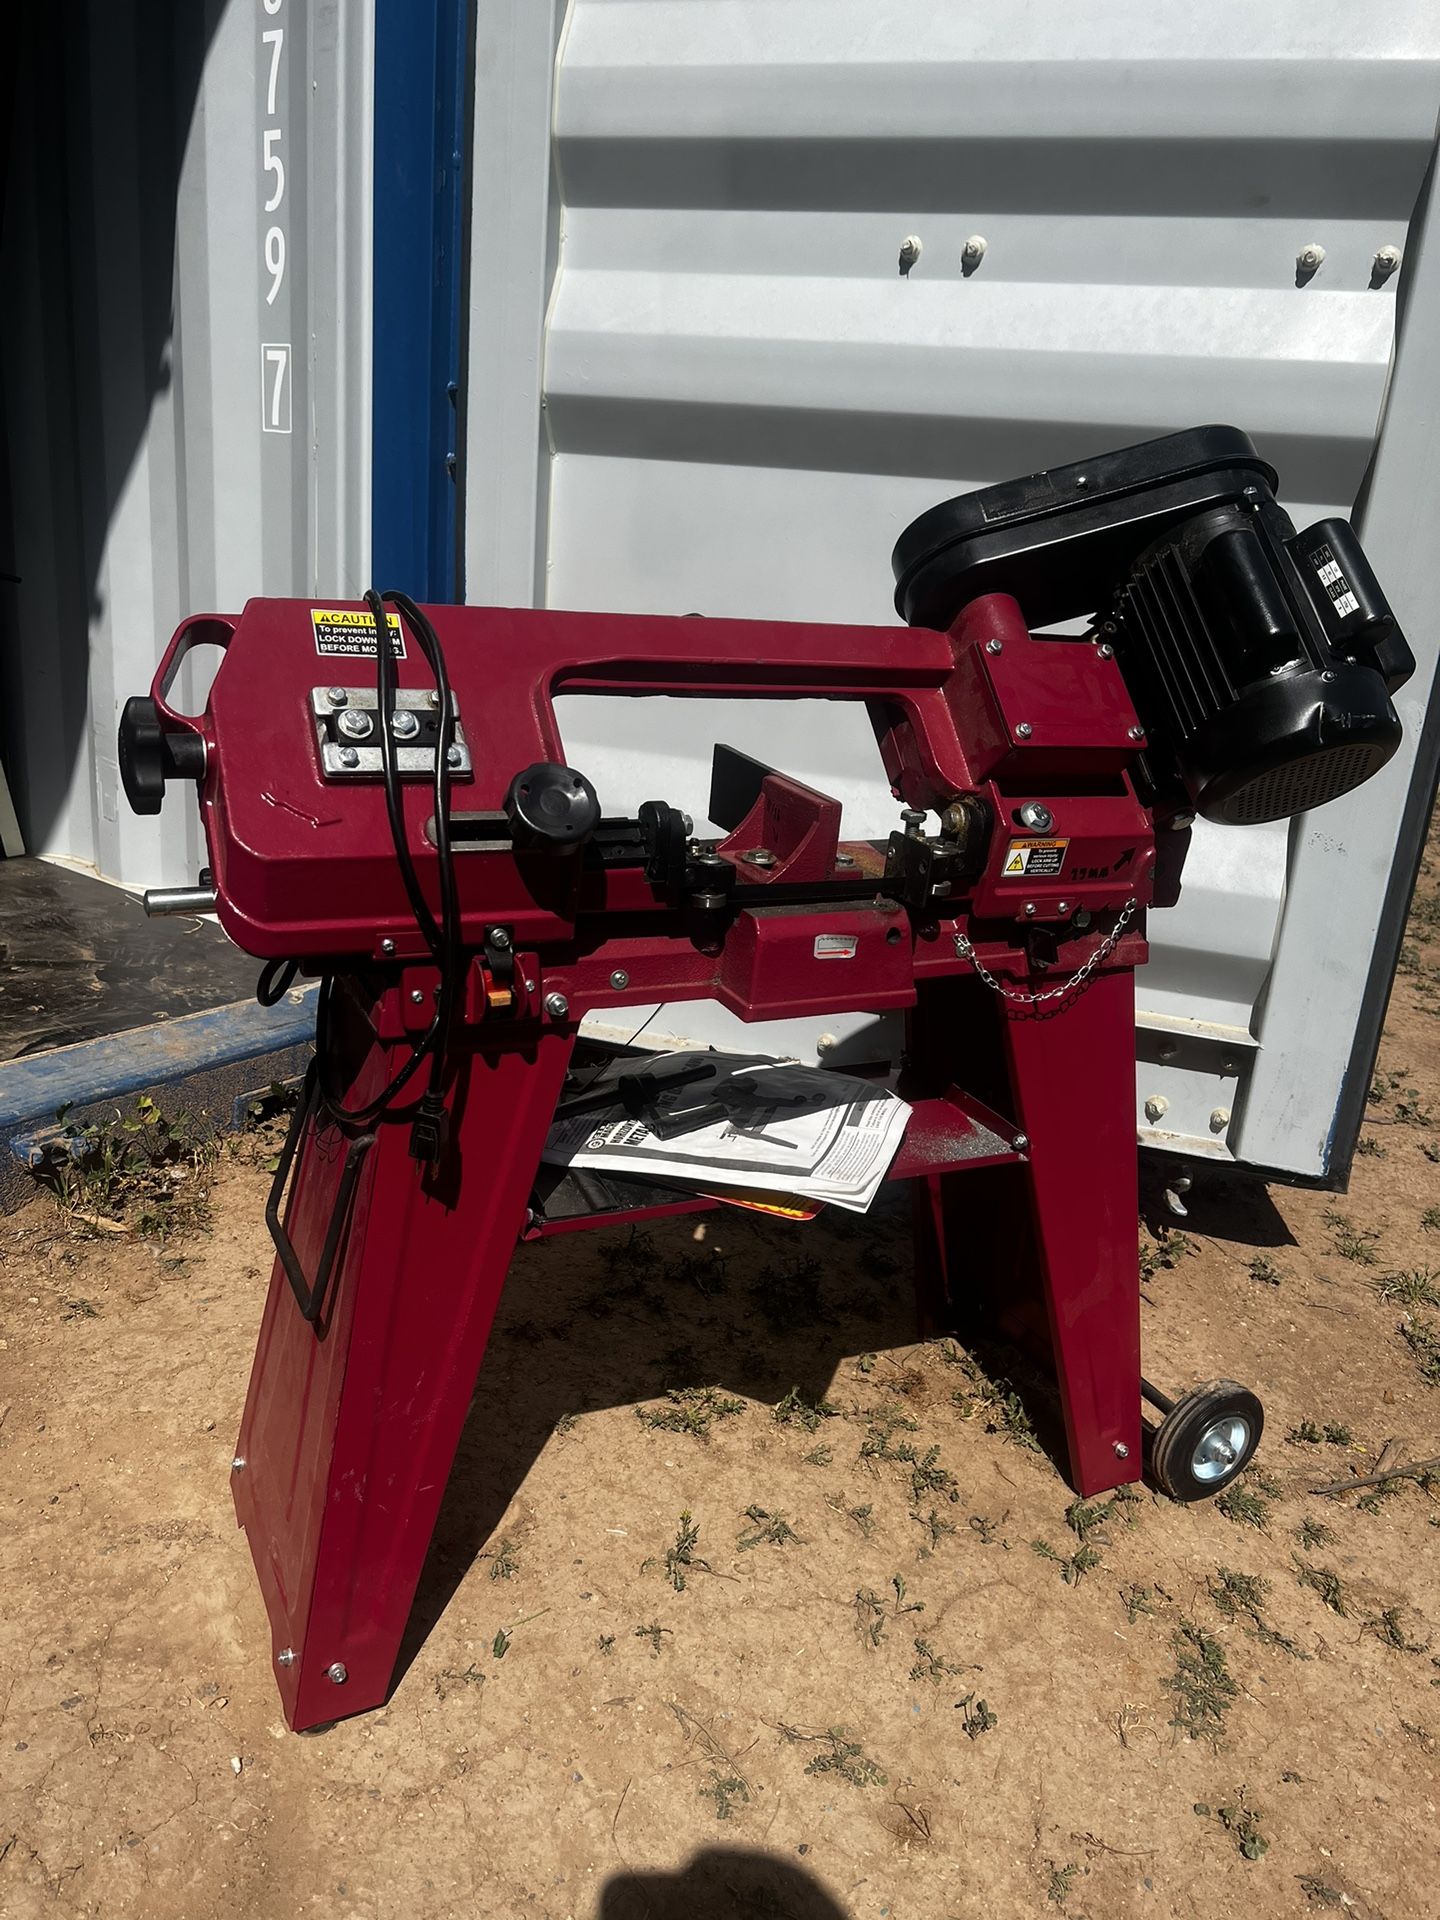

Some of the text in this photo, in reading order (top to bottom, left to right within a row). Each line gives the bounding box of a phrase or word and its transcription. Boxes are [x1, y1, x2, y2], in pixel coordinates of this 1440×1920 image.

[262, 0, 287, 426] 759 7
[331, 614, 392, 625] CAUTIN
[333, 627, 366, 636] prevent
[319, 635, 346, 643] LOCK
[348, 636, 377, 644] DOWN
[320, 643, 360, 652] BEFORE
